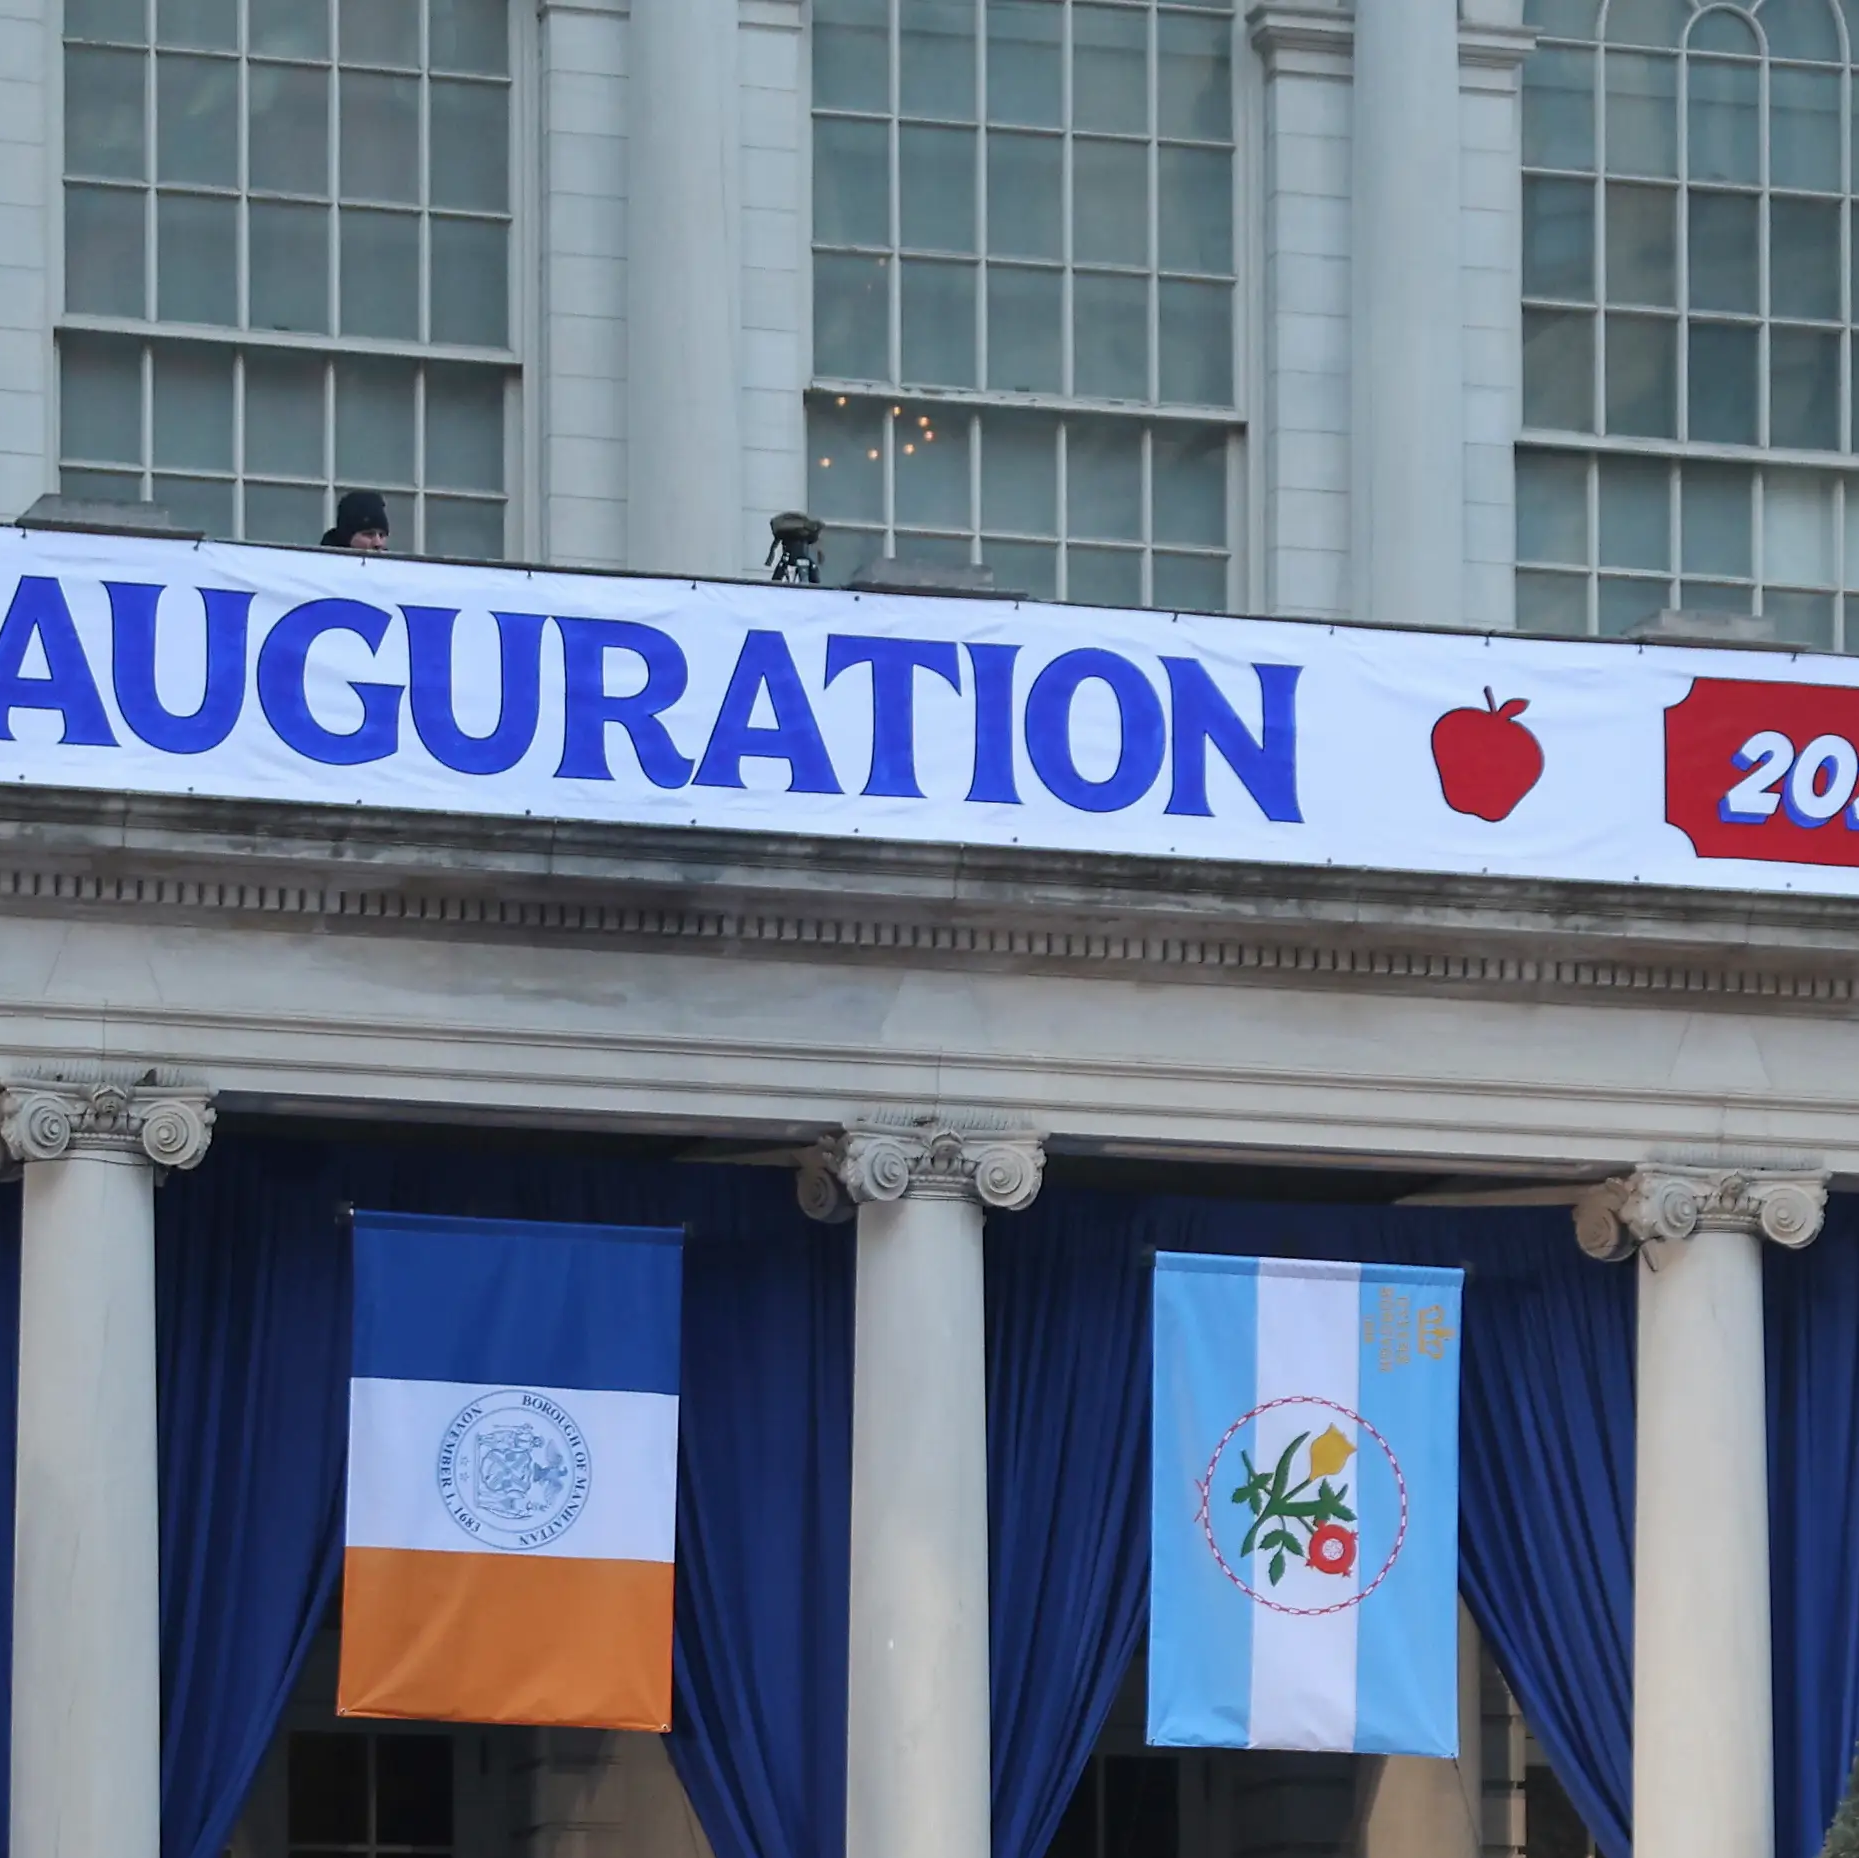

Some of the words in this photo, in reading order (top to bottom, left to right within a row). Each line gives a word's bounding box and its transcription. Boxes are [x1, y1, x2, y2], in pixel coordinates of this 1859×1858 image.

[440, 1403, 483, 1489] NOVEMBER
[522, 1394, 581, 1447] BOROUGH
[575, 1451, 588, 1471] OF
[453, 1507, 482, 1533] 1683
[519, 1476, 588, 1546] MANHATTAN
